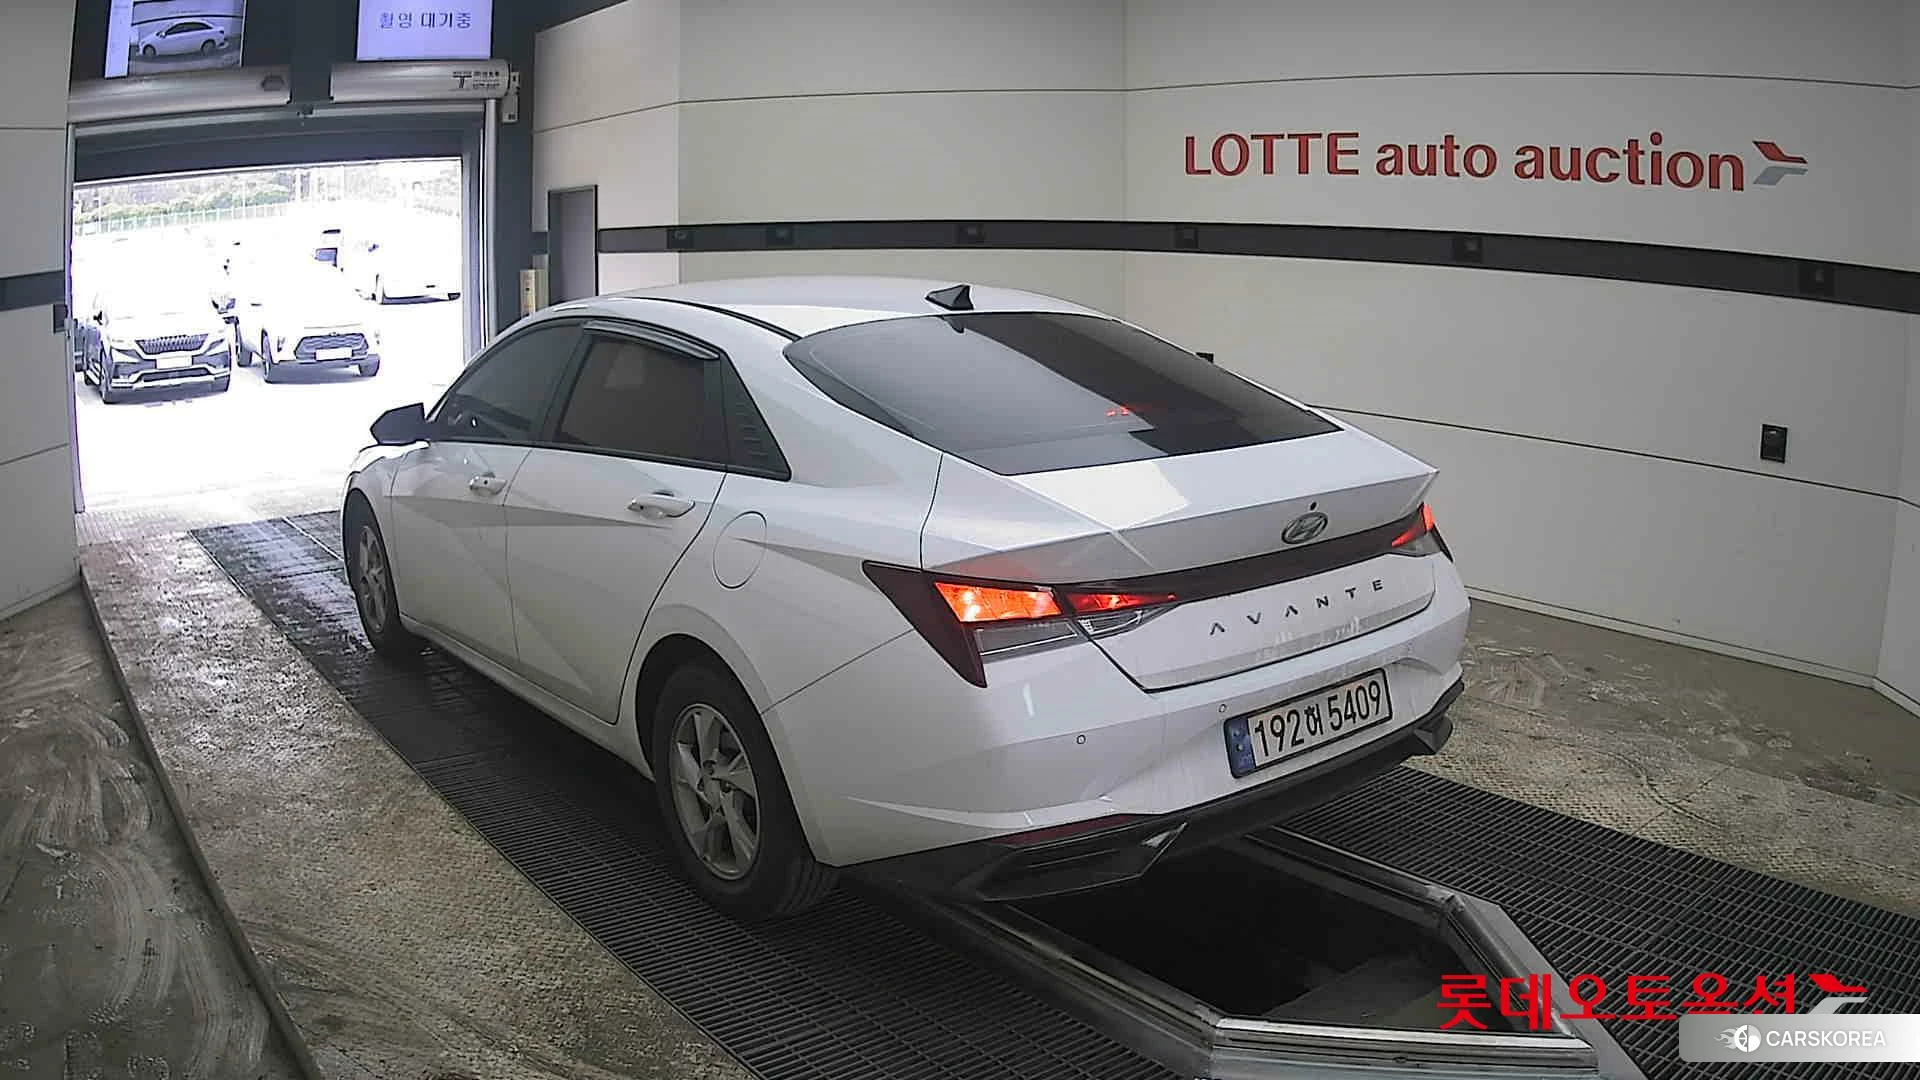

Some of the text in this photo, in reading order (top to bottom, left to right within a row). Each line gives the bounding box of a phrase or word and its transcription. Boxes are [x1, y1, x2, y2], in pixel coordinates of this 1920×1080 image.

[421, 12, 471, 29] 대기중
[1184, 132, 1744, 191] LOTTE auto auction
[1210, 580, 1383, 636] AVANTE
[1327, 680, 1381, 731] 5409
